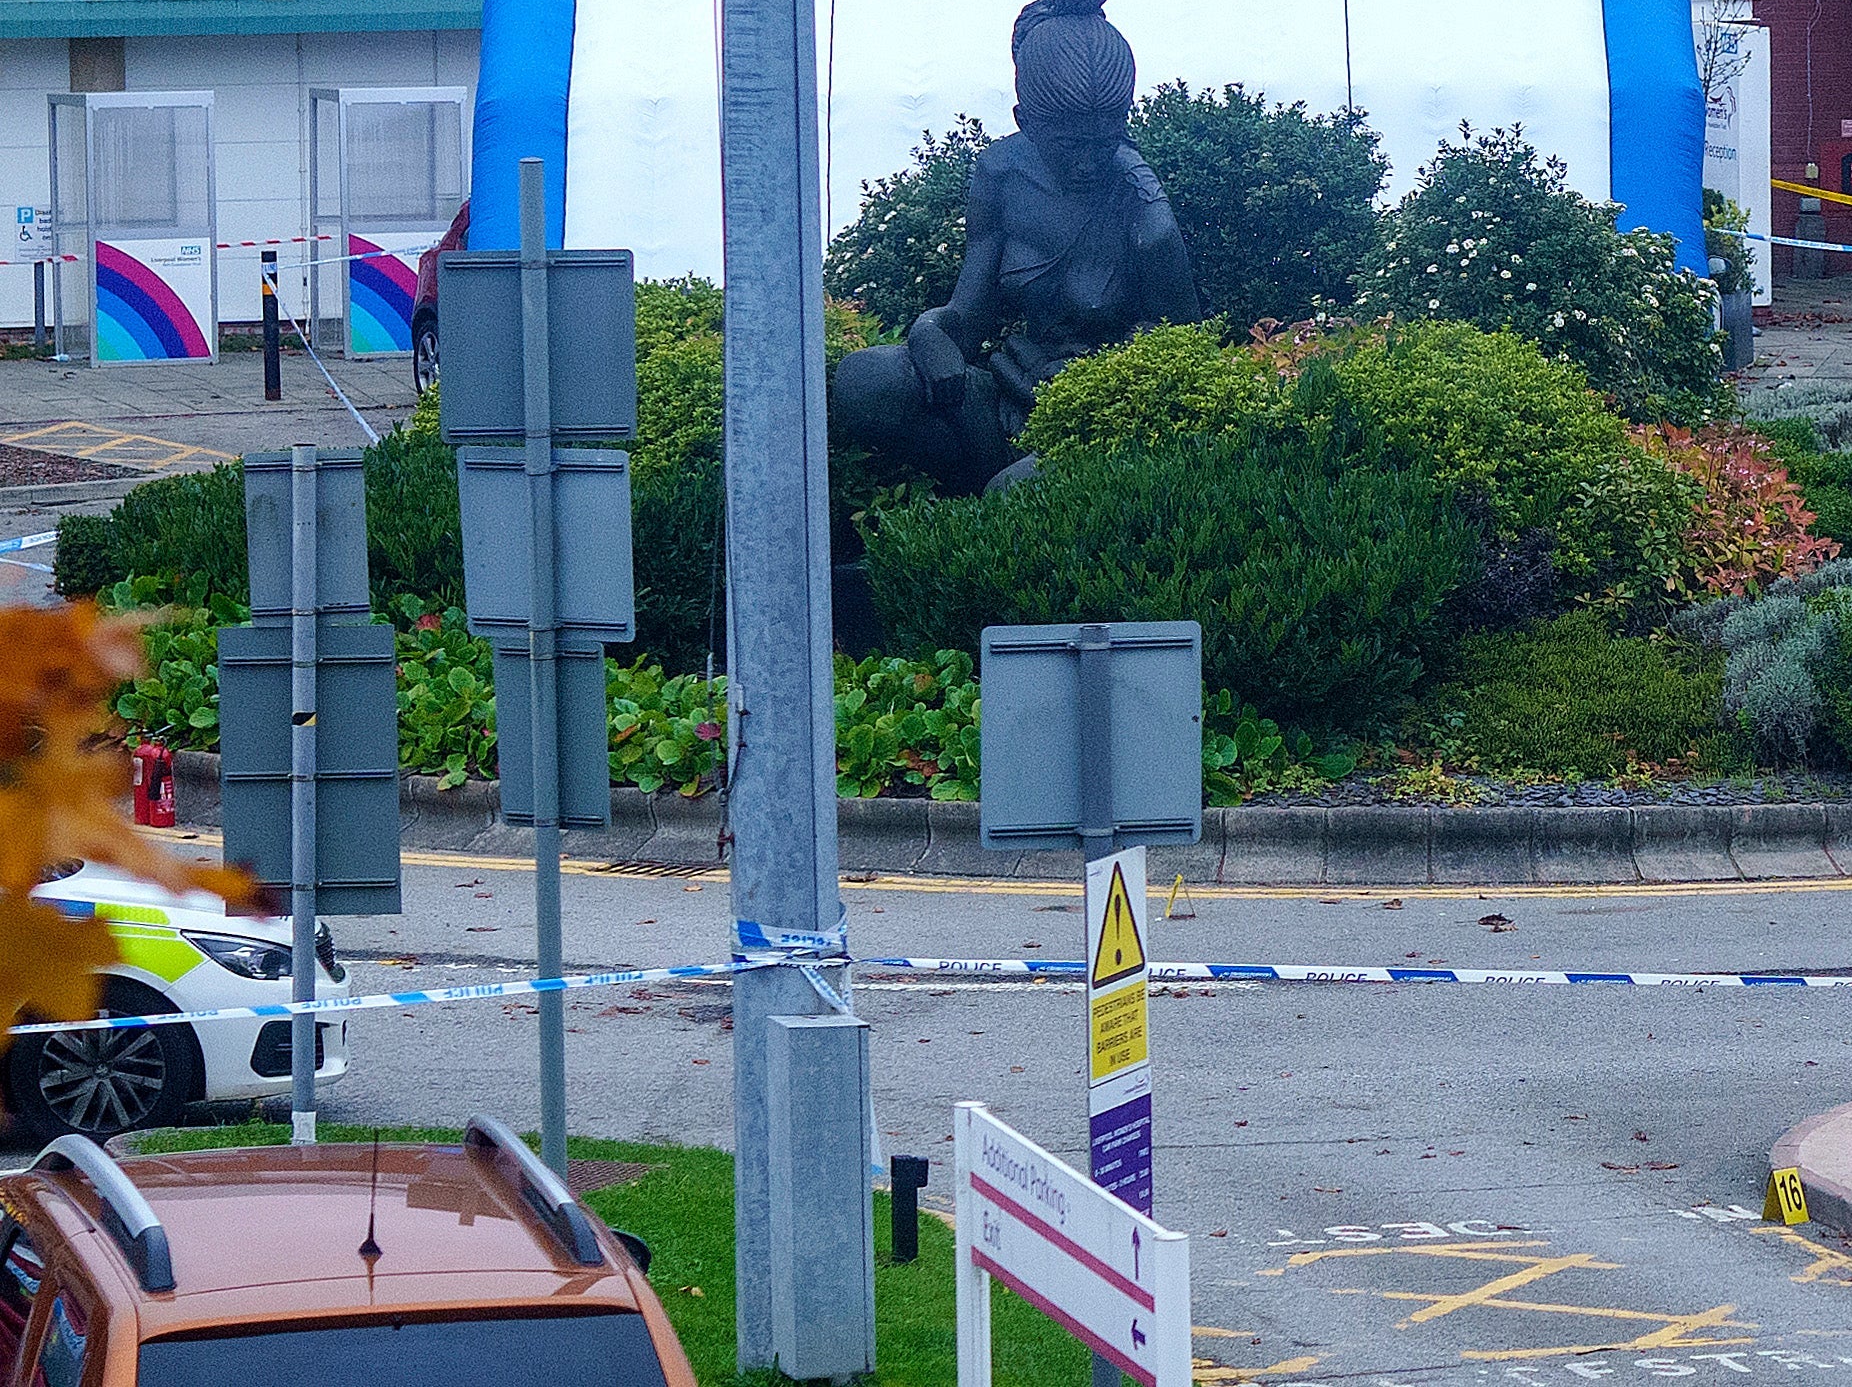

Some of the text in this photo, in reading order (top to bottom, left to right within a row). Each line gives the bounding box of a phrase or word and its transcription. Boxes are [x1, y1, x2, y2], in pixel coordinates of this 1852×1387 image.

[181, 246, 200, 255] NHS
[982, 1133, 1028, 1191] Additional
[1777, 1173, 1804, 1215] 16
